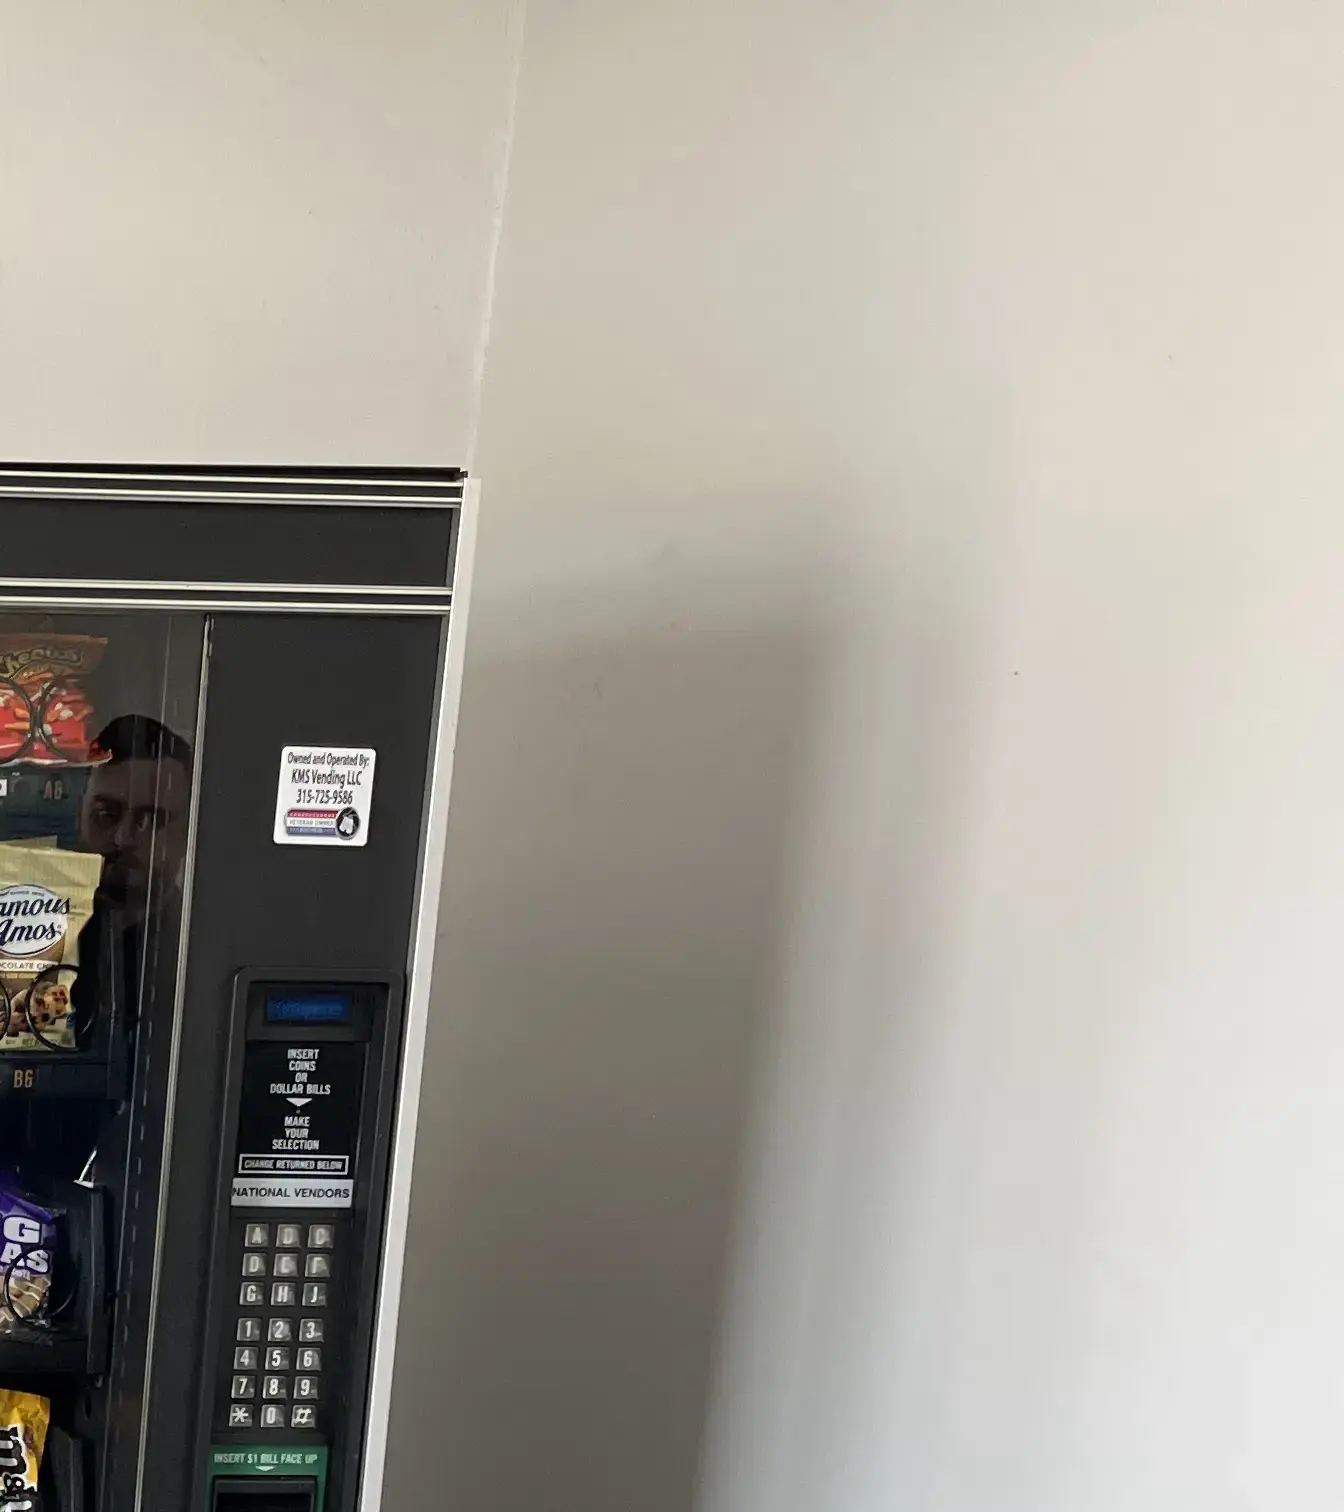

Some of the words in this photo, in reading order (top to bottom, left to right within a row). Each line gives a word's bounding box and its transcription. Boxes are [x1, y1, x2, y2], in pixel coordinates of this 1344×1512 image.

[287, 752, 311, 765] Owned
[312, 753, 325, 765] and
[327, 753, 358, 767] Operated
[291, 769, 310, 785] KMS
[311, 770, 345, 789] Vending
[347, 771, 363, 785] LLC
[296, 789, 353, 805] 315-725-9586
[287, 1048, 320, 1060] INSERT
[288, 1060, 316, 1071] COINS
[14, 1069, 34, 1089] B6
[295, 1072, 308, 1083] OR
[269, 1083, 304, 1095] DOLLAR
[306, 1084, 331, 1095] BILLS
[284, 1116, 311, 1127] MAKE
[284, 1128, 309, 1139] YOUR
[271, 1139, 320, 1150] SELECTION
[244, 1159, 275, 1170] CHANGE
[275, 1160, 316, 1171] RETURNED
[316, 1161, 343, 1171] BELOW
[232, 1187, 290, 1198] NATIONAL
[293, 1188, 350, 1199] VENDORS
[251, 1226, 262, 1244] A
[249, 1256, 259, 1273] D
[246, 1285, 257, 1302] G
[278, 1286, 289, 1303] H
[311, 1286, 318, 1303] J
[245, 1320, 252, 1337] 1
[274, 1321, 284, 1338] 2
[306, 1322, 316, 1339] 3
[240, 1349, 250, 1366] 4
[271, 1350, 281, 1367] 5
[303, 1350, 312, 1367] 6
[238, 1377, 248, 1394] 7
[269, 1379, 279, 1395] 8
[300, 1379, 310, 1396] 9
[266, 1407, 276, 1424] 0
[213, 1453, 245, 1464] INSERT
[247, 1453, 258, 1465] $1
[260, 1453, 279, 1464] BILL
[280, 1453, 302, 1465] FACE
[305, 1453, 318, 1465] UP
